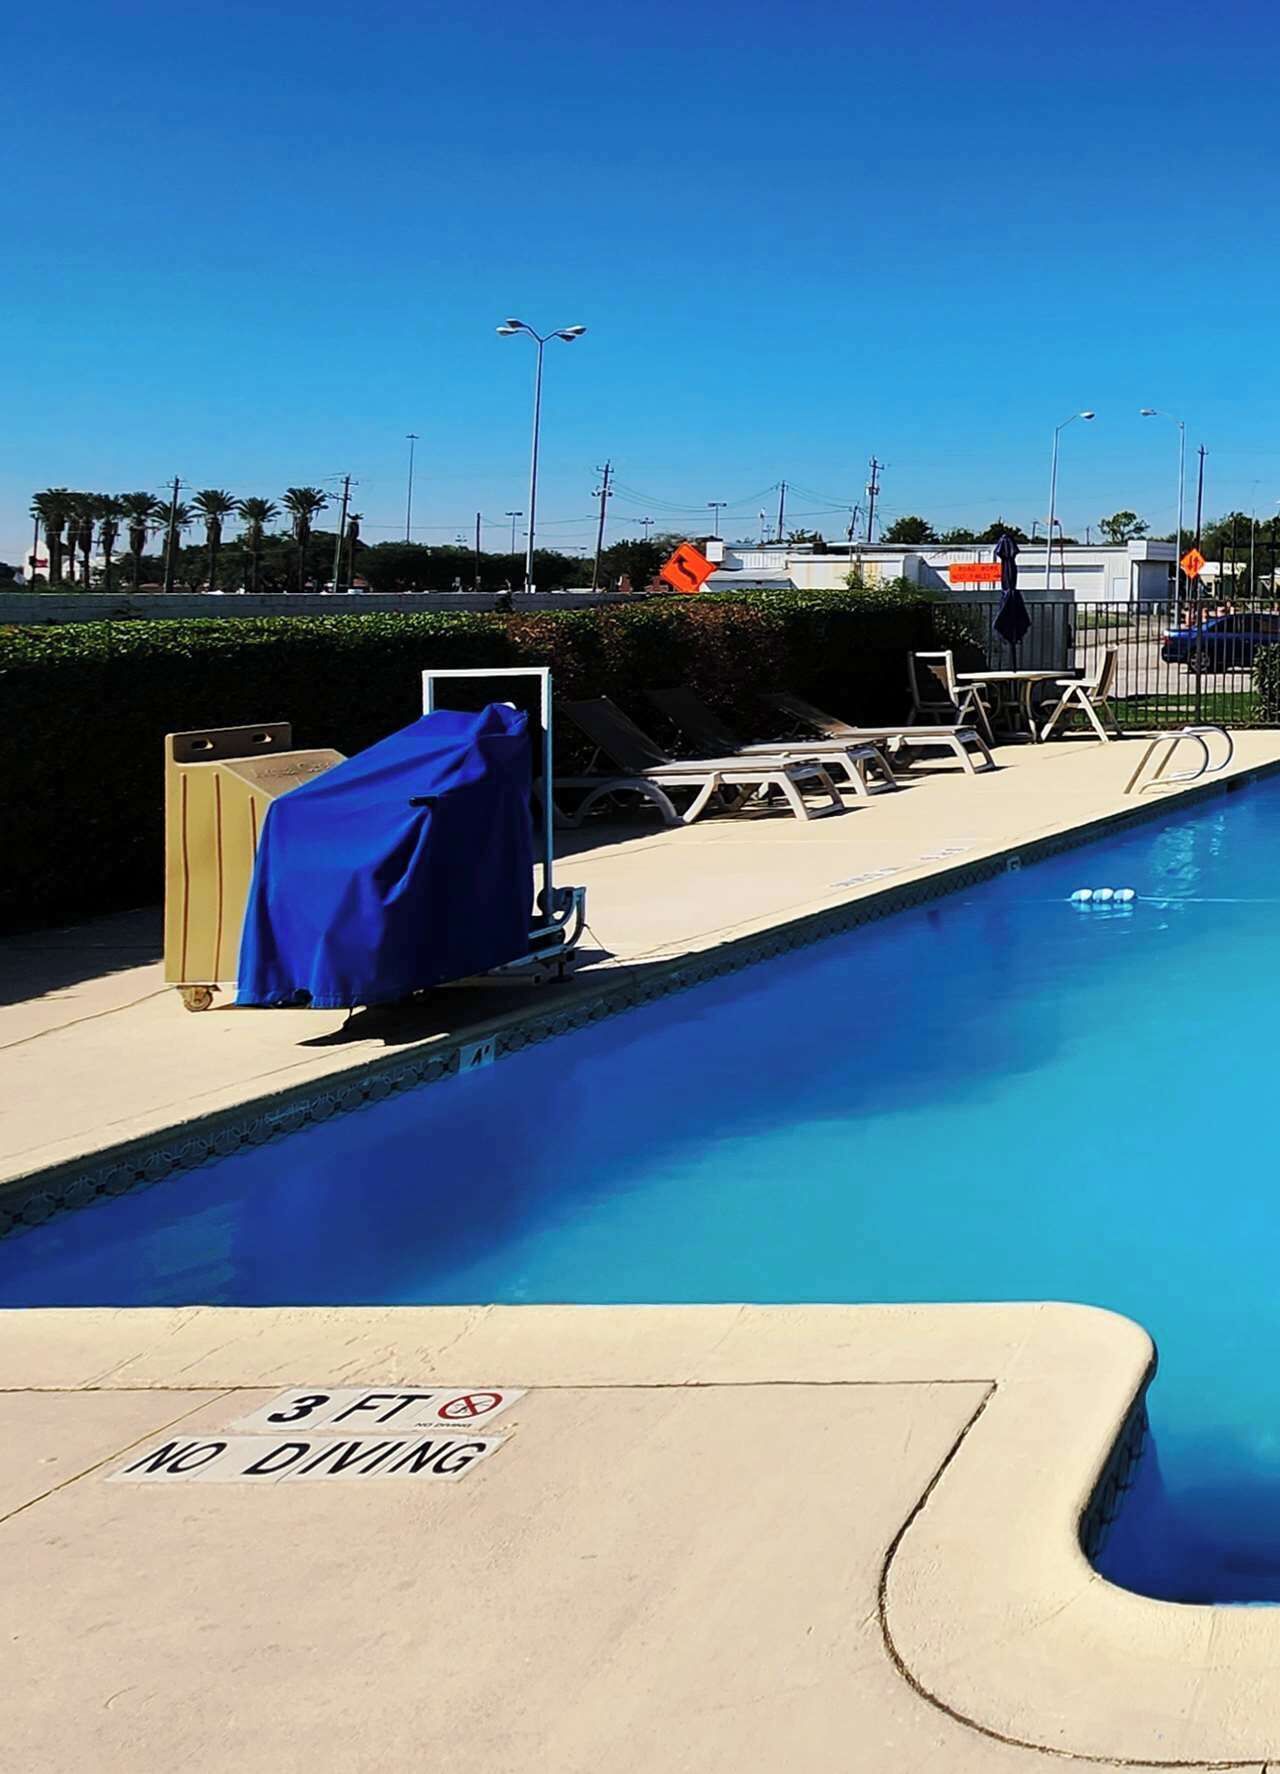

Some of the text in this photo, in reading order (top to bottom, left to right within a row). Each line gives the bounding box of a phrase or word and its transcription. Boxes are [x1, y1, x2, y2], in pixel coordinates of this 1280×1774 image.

[266, 1394, 434, 1423] 3 FT
[123, 1441, 487, 1476] NO DIVING
